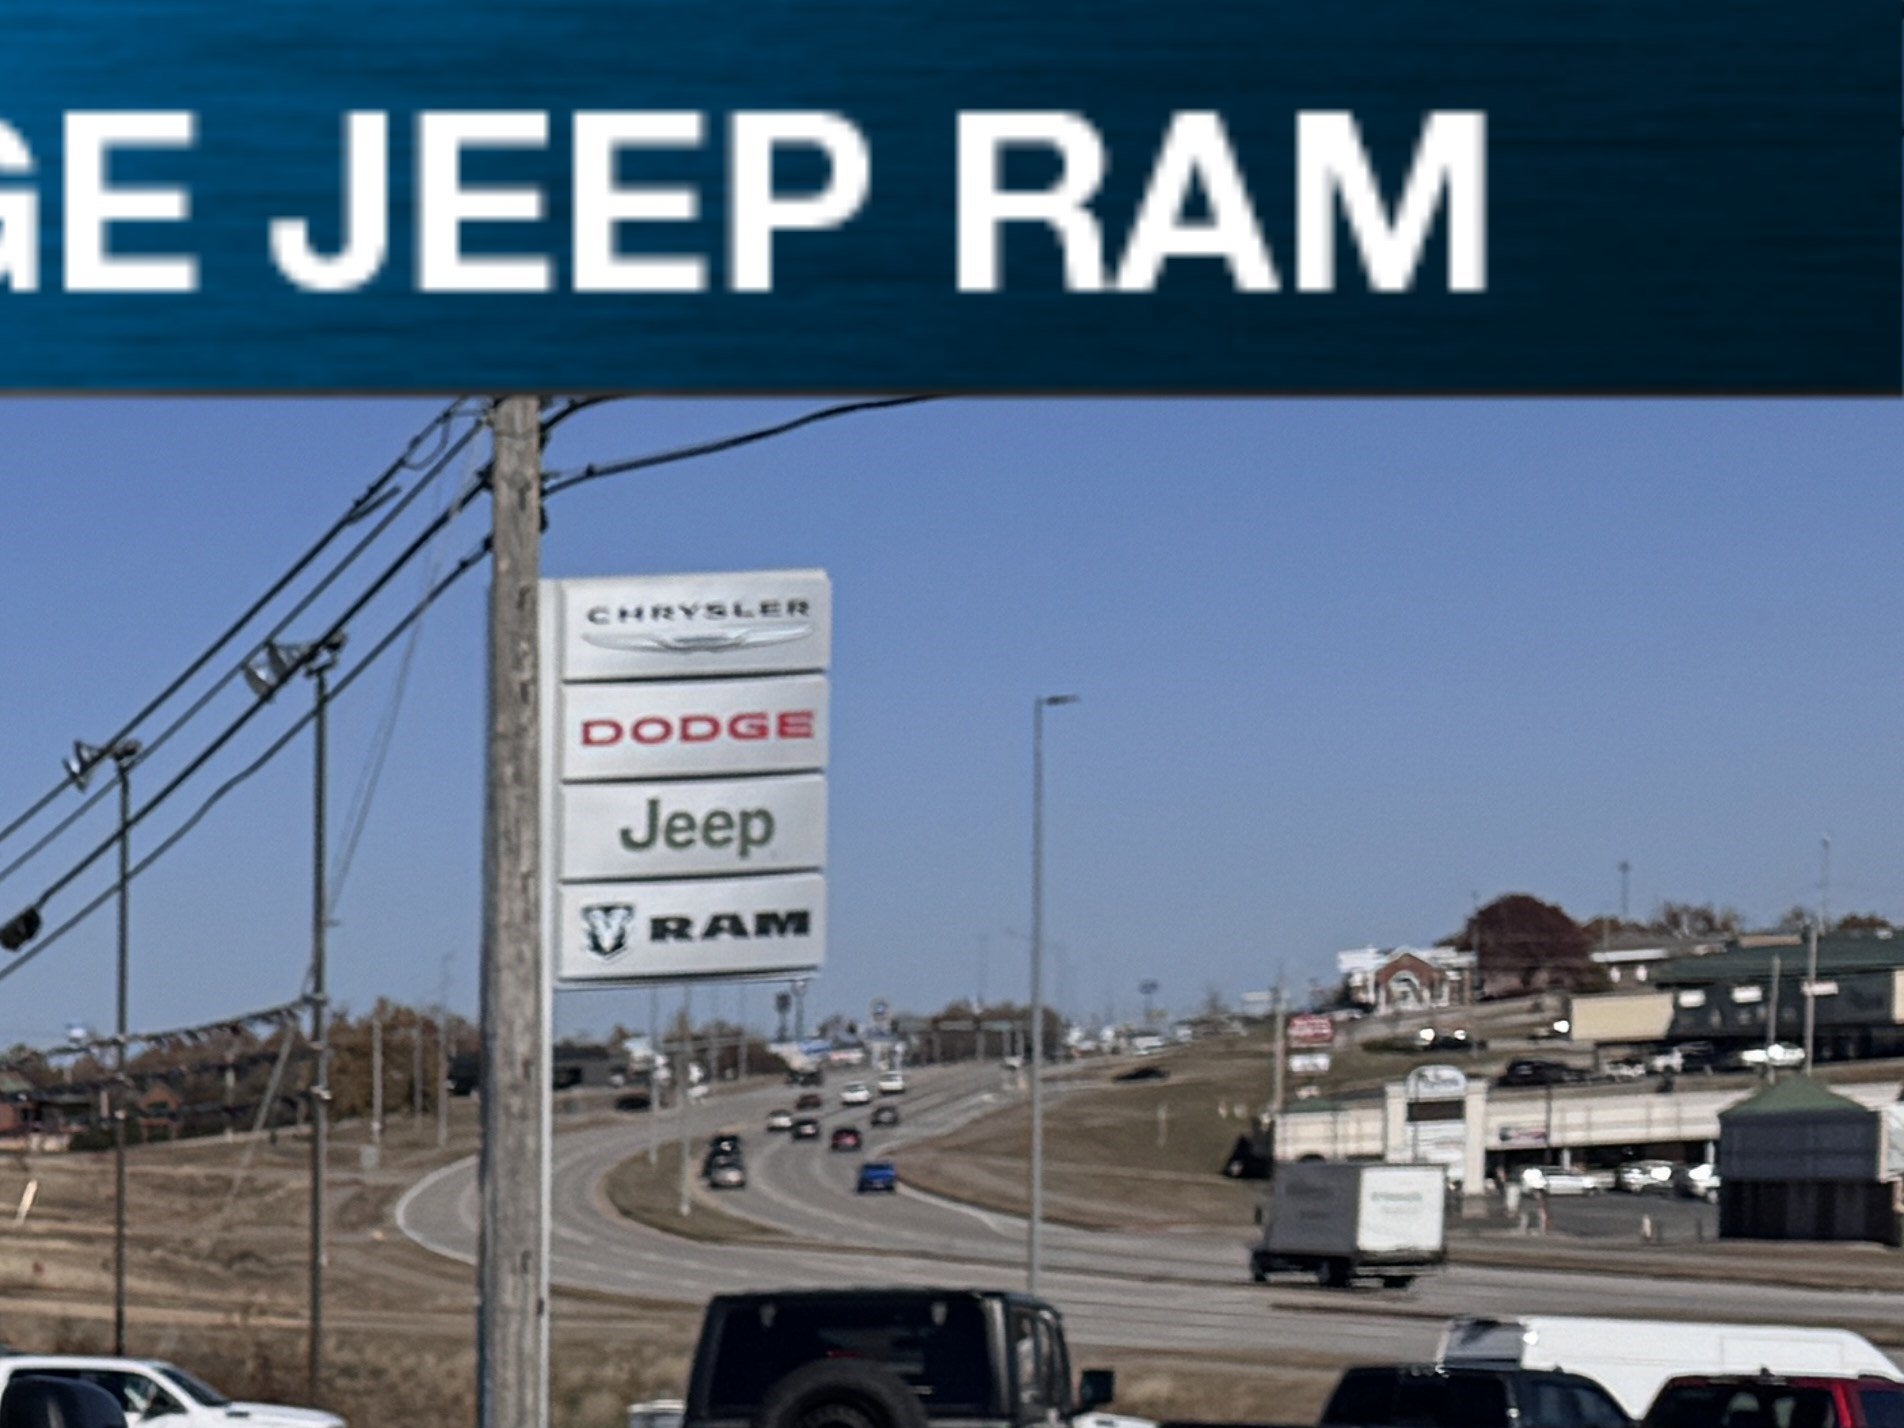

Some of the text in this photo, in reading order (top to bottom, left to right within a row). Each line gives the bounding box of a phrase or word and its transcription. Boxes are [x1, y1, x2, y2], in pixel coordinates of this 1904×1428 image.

[587, 598, 810, 625] CHRYSLER
[580, 710, 815, 747] DODGE
[619, 798, 775, 858] Jeep
[648, 909, 811, 942] RAM
